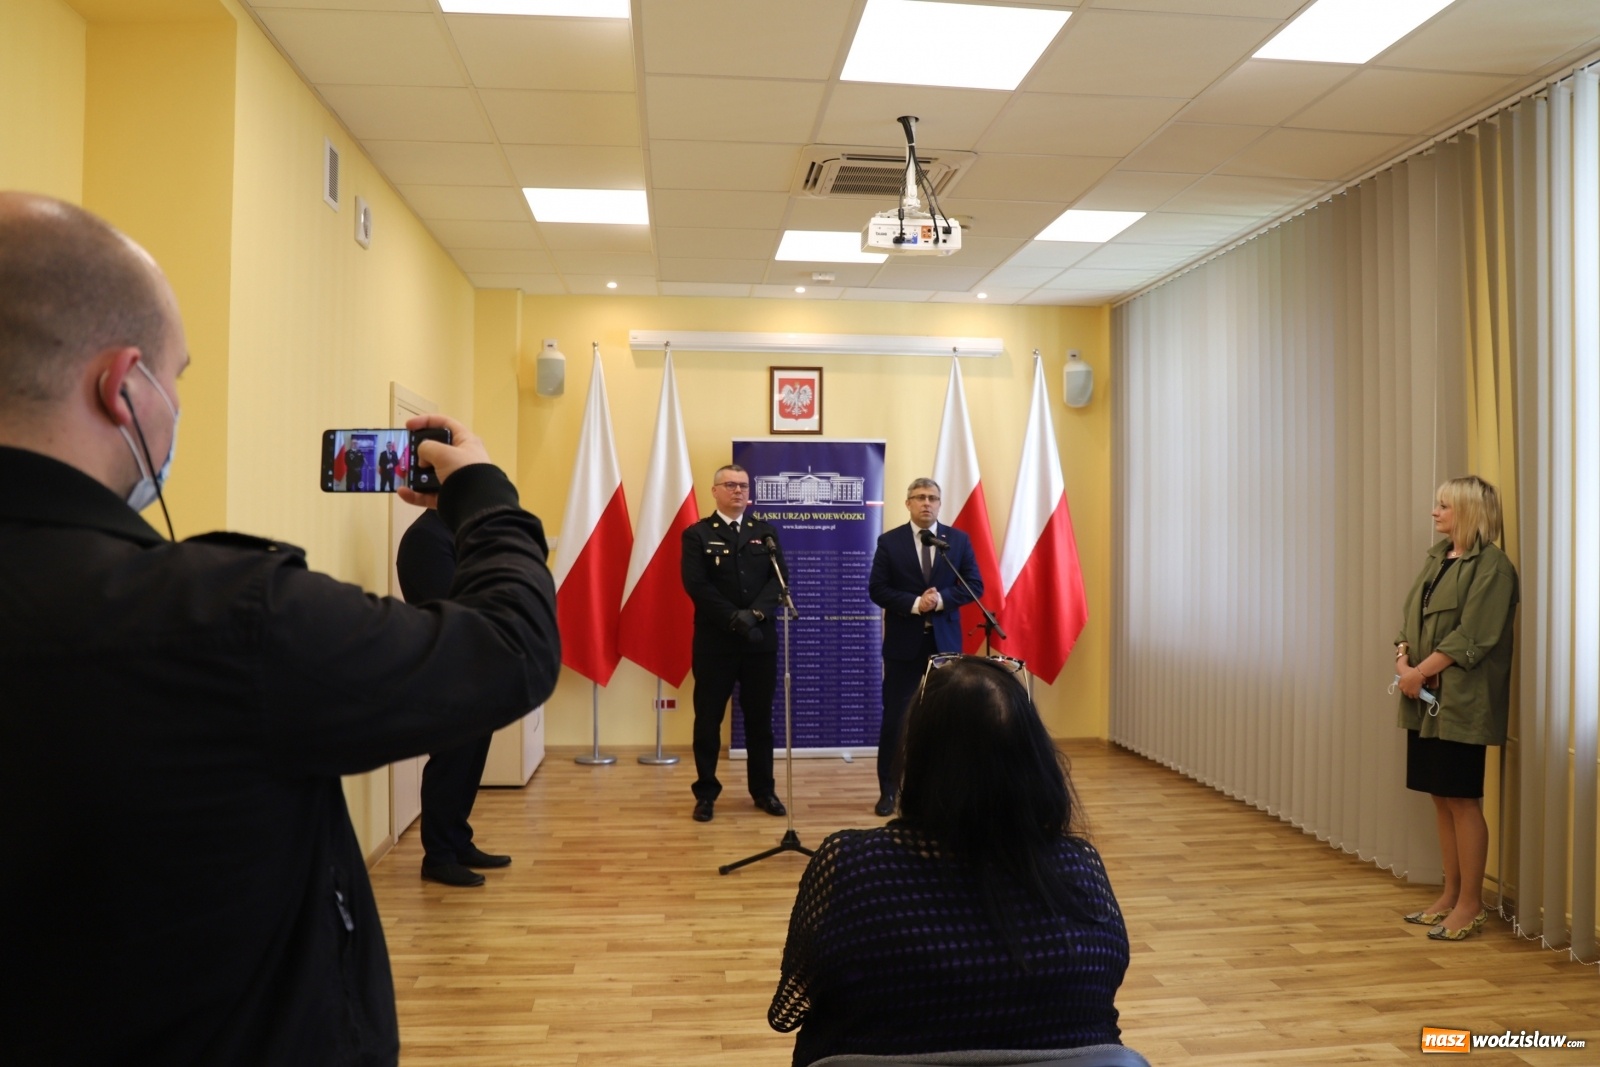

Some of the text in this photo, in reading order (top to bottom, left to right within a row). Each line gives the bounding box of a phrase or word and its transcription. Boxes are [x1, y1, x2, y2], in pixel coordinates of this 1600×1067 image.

[752, 510, 866, 521] ŚLĄSKI URZĄD WOJEWÓDZKI
